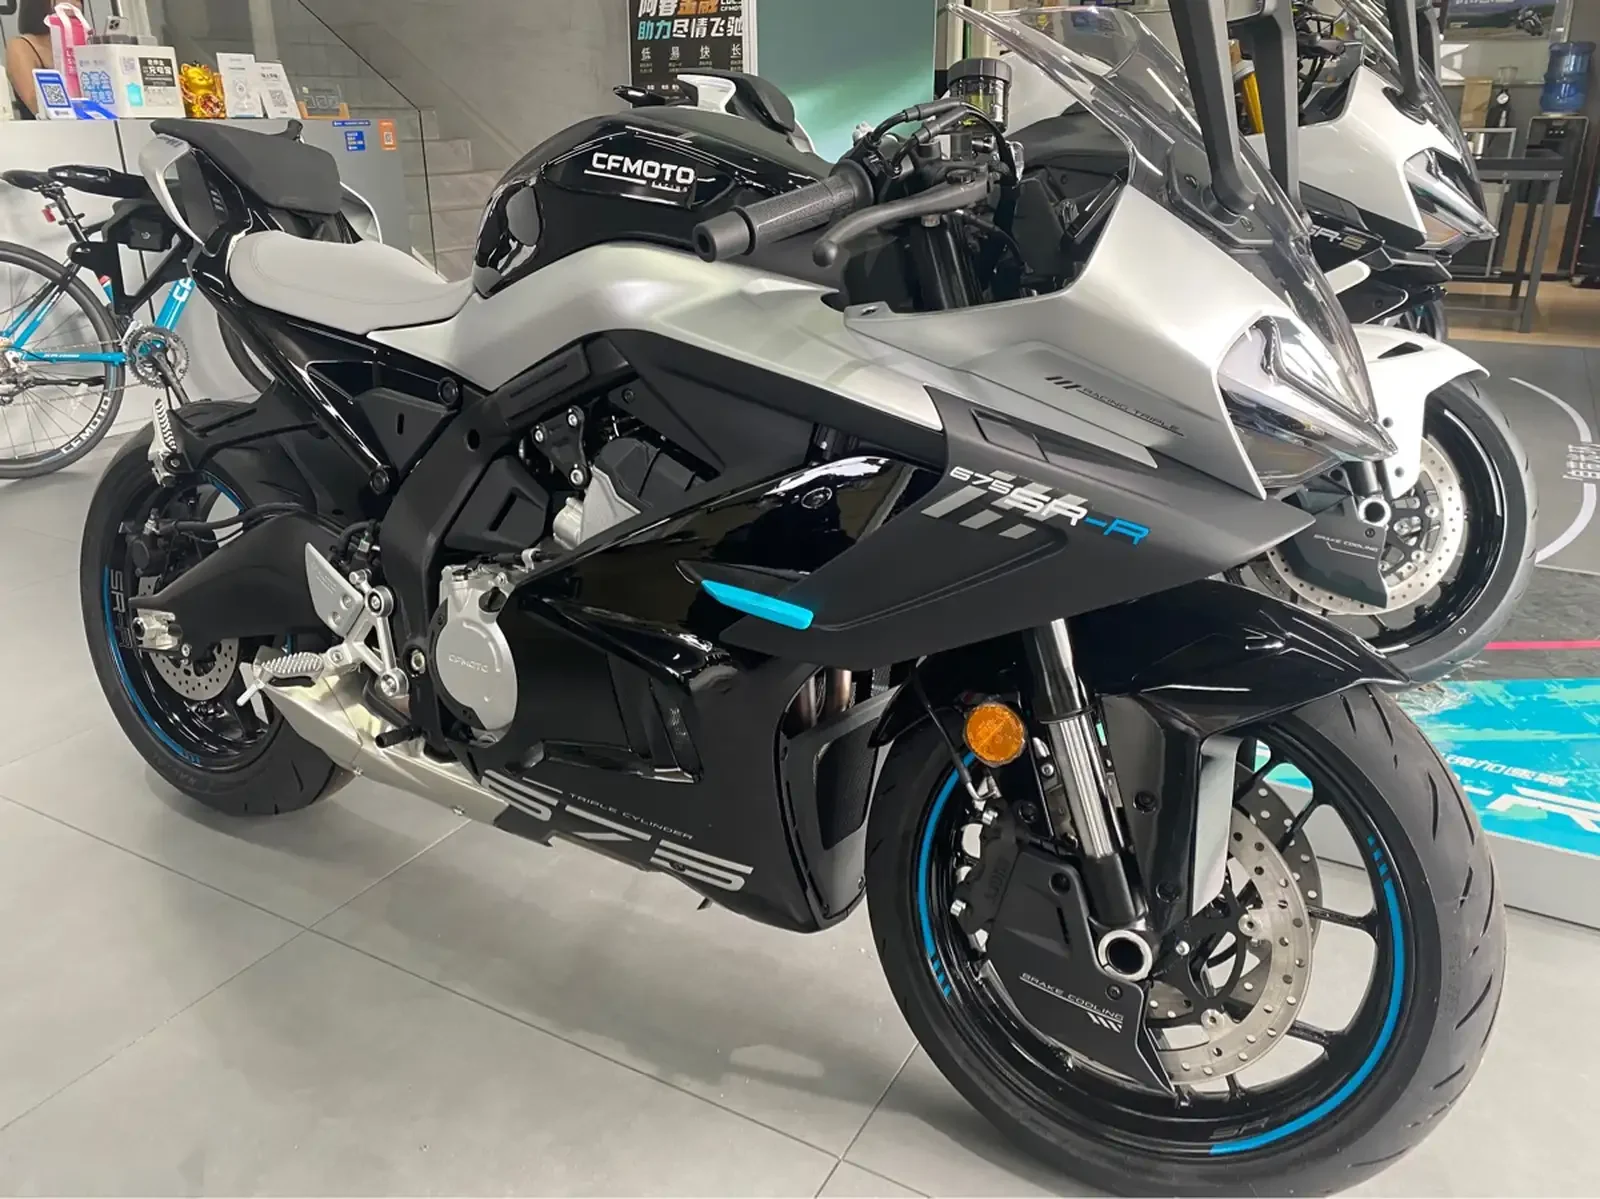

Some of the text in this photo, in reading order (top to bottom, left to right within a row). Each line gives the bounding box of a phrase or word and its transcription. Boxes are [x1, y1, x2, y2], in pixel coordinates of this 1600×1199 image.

[731, 44, 742, 56] 长
[591, 152, 695, 185] CFMOTO
[60, 396, 111, 455] CFMOTO
[1080, 386, 1181, 431] RACING TRIPLE
[449, 653, 489, 674] CFMOTO
[568, 791, 694, 841] TRIPLE CYLINDER
[1021, 972, 1125, 1022] BRAKE COOLING
